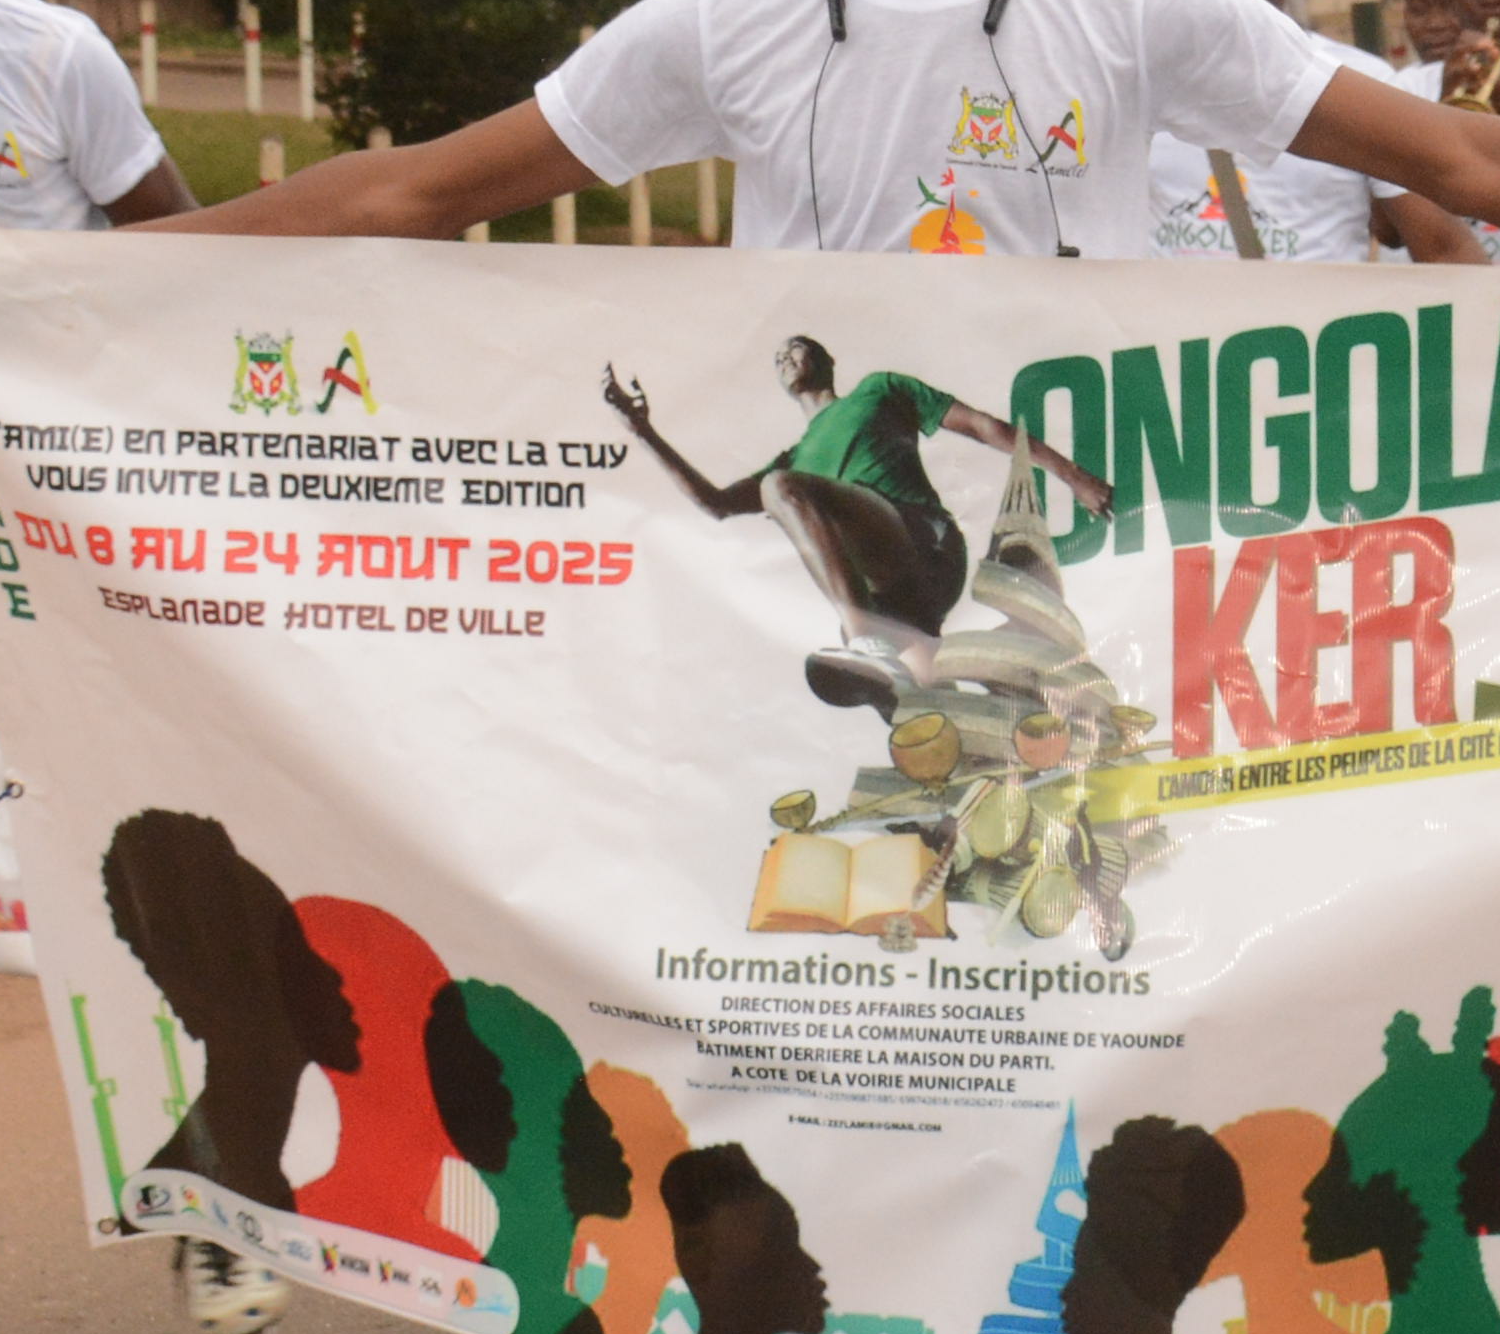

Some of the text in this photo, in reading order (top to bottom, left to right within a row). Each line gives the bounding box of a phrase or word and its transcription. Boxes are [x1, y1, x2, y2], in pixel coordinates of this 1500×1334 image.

[176, 429, 400, 463] PARTENARIAT
[411, 436, 497, 466] AVEC
[508, 440, 548, 467] LA
[25, 464, 586, 509] VOUS INVITE LA DEUXIEME EDITION
[13, 510, 634, 587] DU 8 AU 24 AOUT 2025
[97, 586, 546, 638] ESPLANADE HOTEL DE VILLE
[1171, 515, 1457, 760] KER
[1238, 758, 1293, 792] ENTRE
[1295, 753, 1327, 785] LES
[1328, 744, 1407, 779] PEUPLES
[1408, 742, 1432, 770] DE
[1433, 738, 1456, 767] LA
[1458, 727, 1496, 761] CITÉ
[655, 946, 896, 988] Informations
[928, 957, 1152, 1002] Inscriptions
[588, 1000, 1187, 1049] CULTURELLES ET SPORTIVES DE LA COMMUNAUTE URBAINE DE YAOUNDE
[721, 995, 1026, 1023] DIRECTION DES AFFAIRES SOCIALES
[696, 1039, 1056, 1071] BATIMENT DERRIERE LA MAISON DU PARTI.
[730, 1065, 1018, 1093] A COTE DE LA VOIRIE MUNICIPALE
